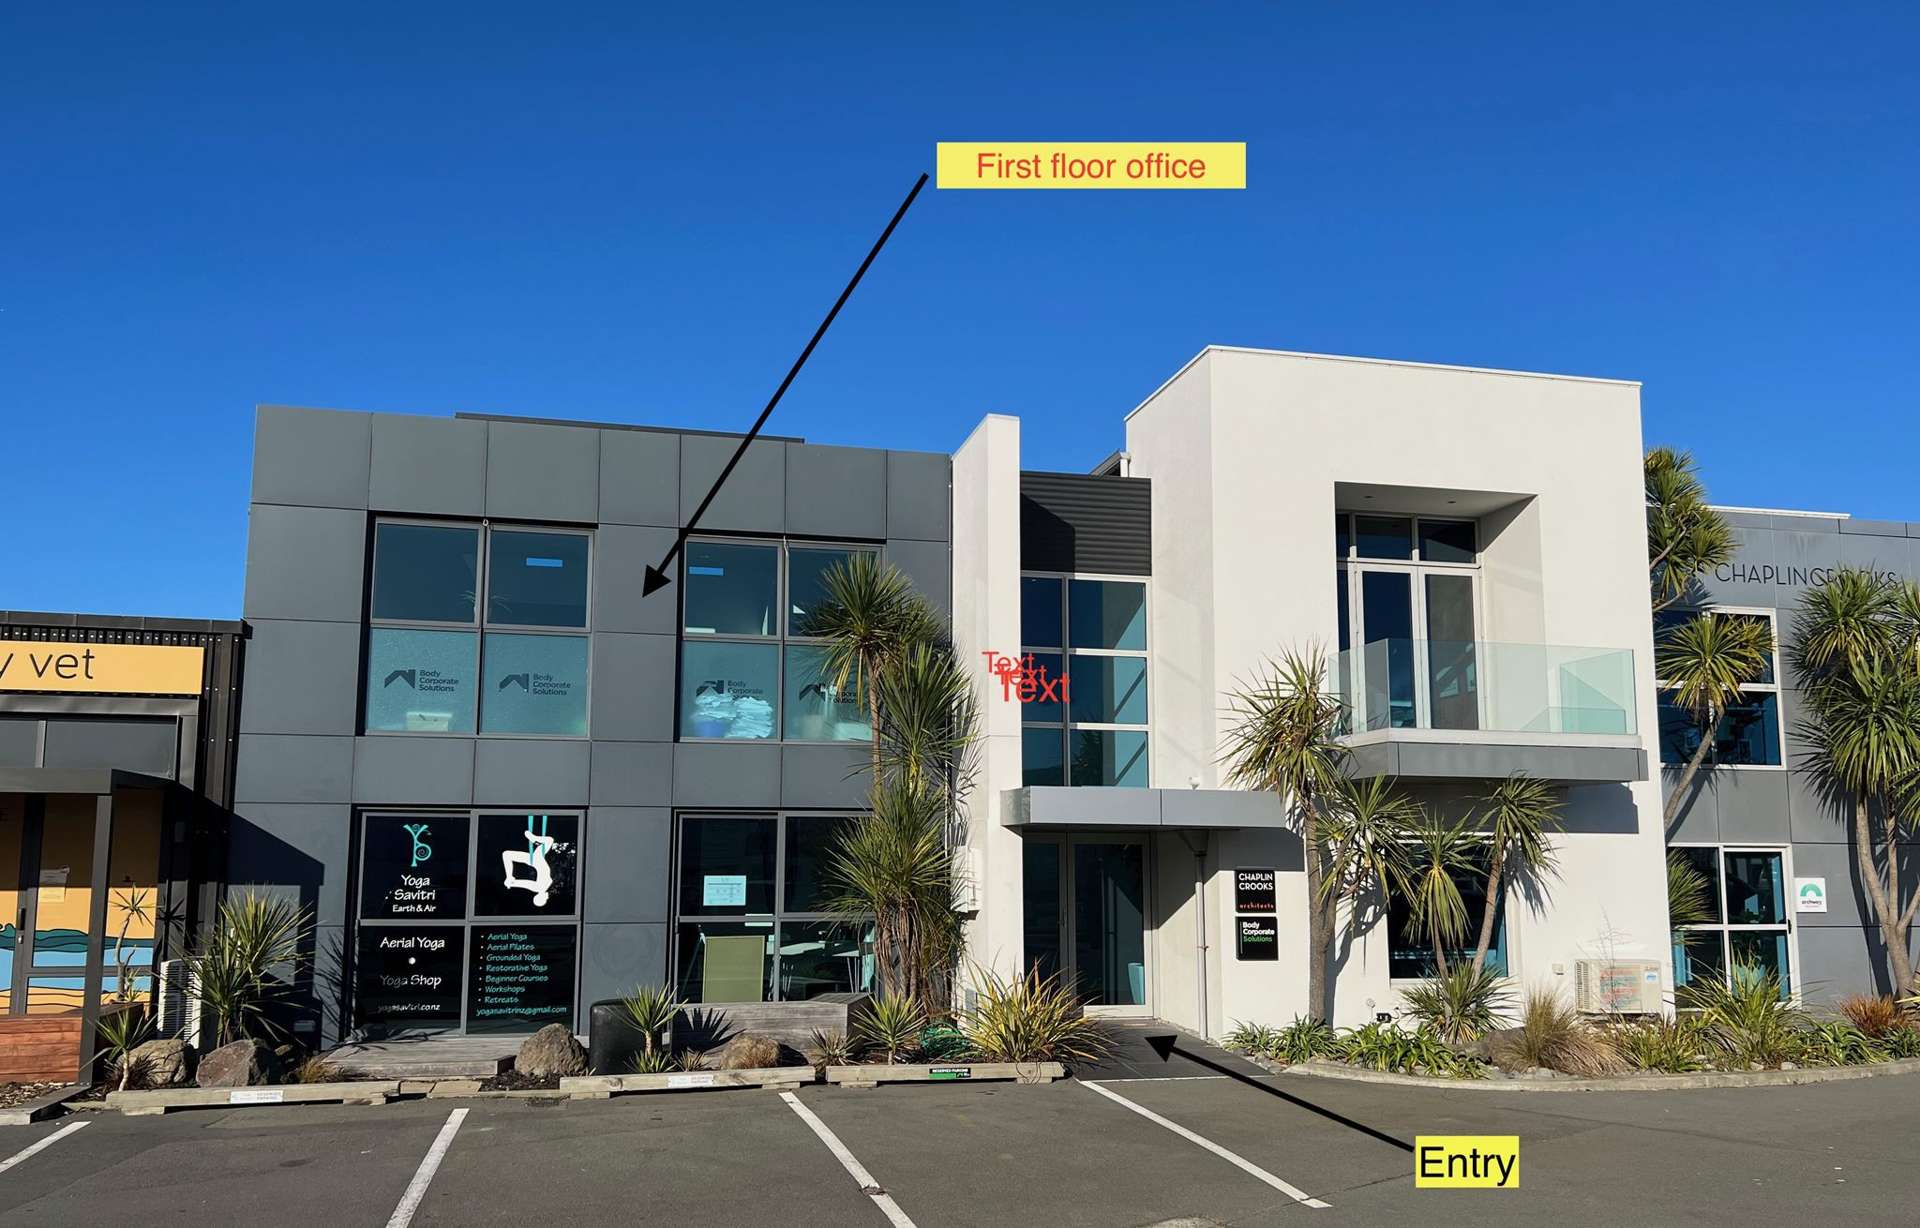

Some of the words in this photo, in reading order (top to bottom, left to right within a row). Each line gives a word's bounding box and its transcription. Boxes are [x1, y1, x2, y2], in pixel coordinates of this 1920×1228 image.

[29, 649, 95, 680] vet
[419, 670, 441, 678] Body
[533, 673, 553, 682] Body
[419, 677, 459, 685] Corporate
[401, 874, 431, 889] Yoga
[1238, 873, 1273, 881] CHAPLIN
[1238, 882, 1273, 890] CROOKS
[394, 889, 436, 901] Savitri
[392, 904, 416, 912] Earth
[416, 904, 422, 912] &
[424, 904, 436, 912] Air
[1242, 921, 1260, 929] Body
[487, 933, 509, 941] Aerial
[510, 933, 528, 942] Yoga
[380, 936, 415, 948] Aerial
[417, 937, 446, 951] Yoga
[486, 943, 509, 951] Aerial
[509, 943, 536, 951] Pilates
[486, 953, 522, 962] Grounded
[523, 953, 541, 963] Yoga
[485, 964, 529, 972] Restorative
[530, 963, 549, 973] Yoga
[380, 975, 408, 988] Yoga
[410, 974, 442, 989] Shop
[485, 974, 518, 984] Beginner
[519, 974, 549, 982] Courses
[484, 985, 526, 995] Workshops
[484, 996, 520, 1004] Retreats
